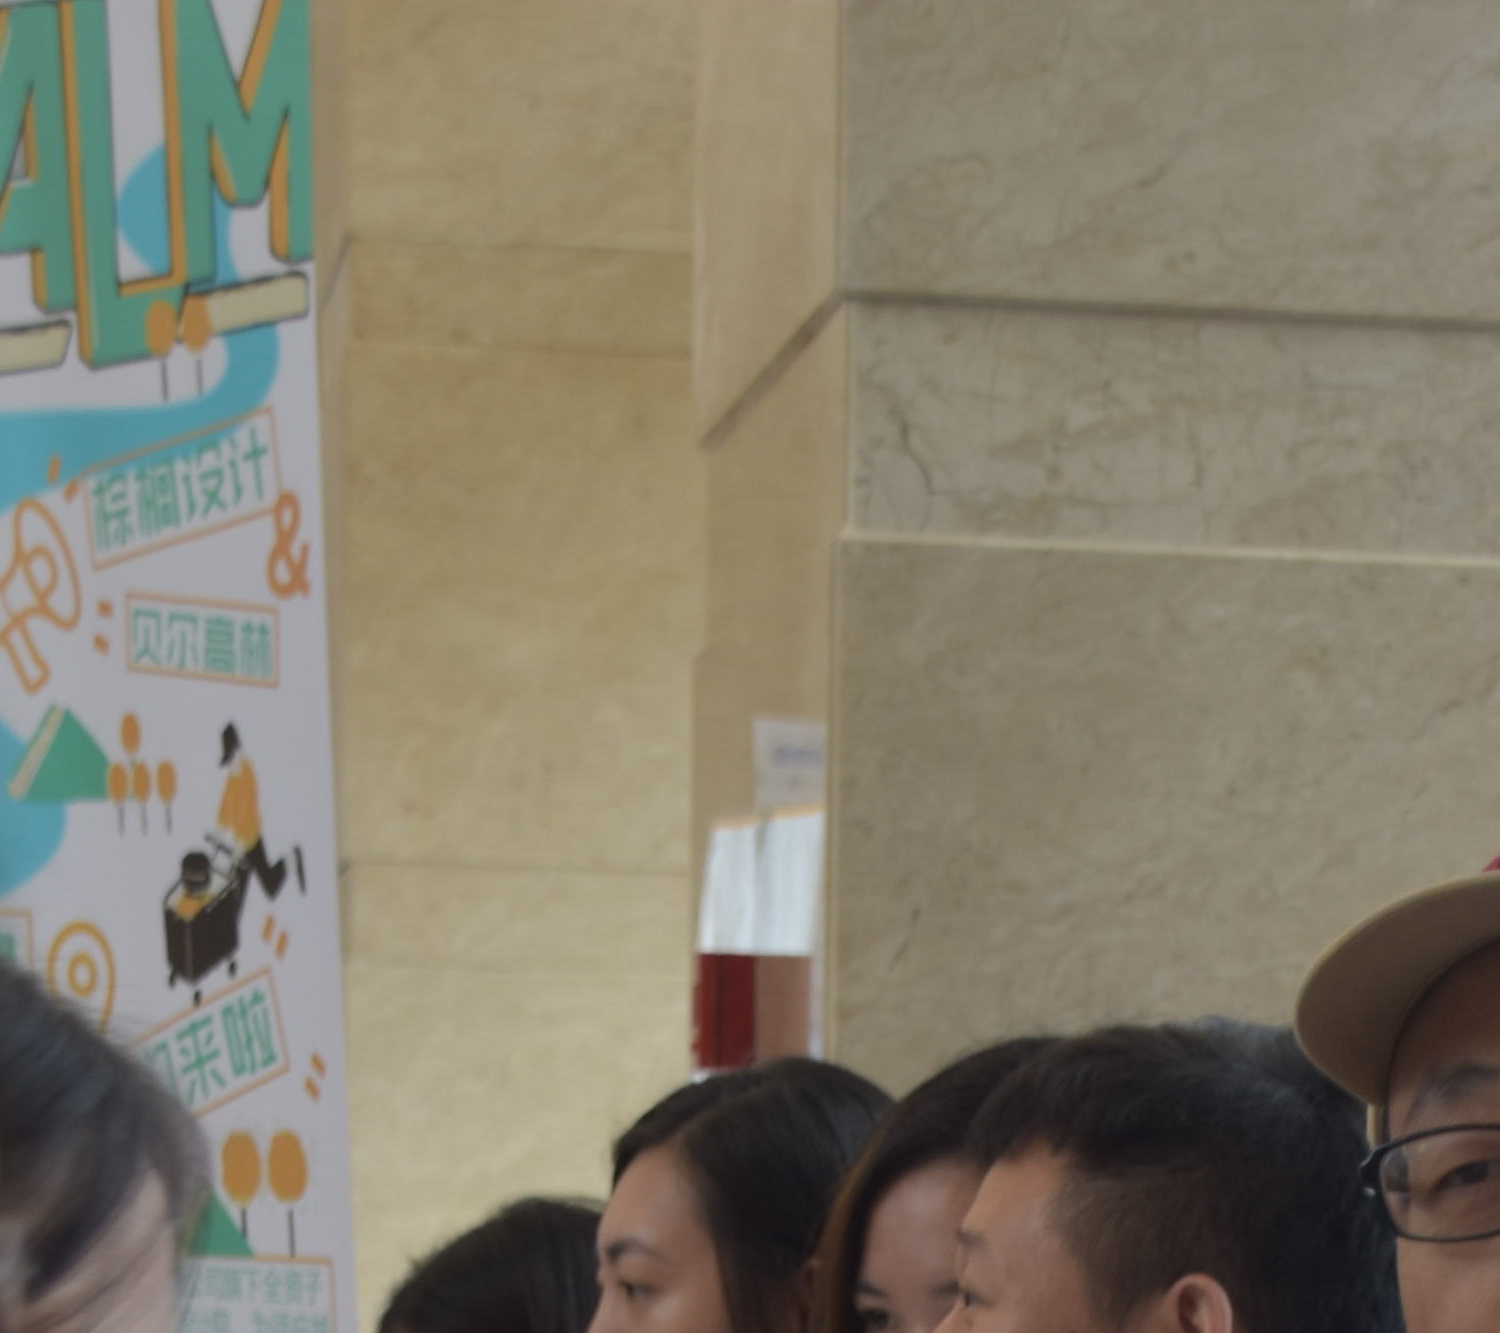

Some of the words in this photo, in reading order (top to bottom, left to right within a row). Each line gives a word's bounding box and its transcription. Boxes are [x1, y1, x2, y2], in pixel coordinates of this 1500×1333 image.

[266, 489, 311, 600] &
[131, 604, 273, 679] 贝尔高林
